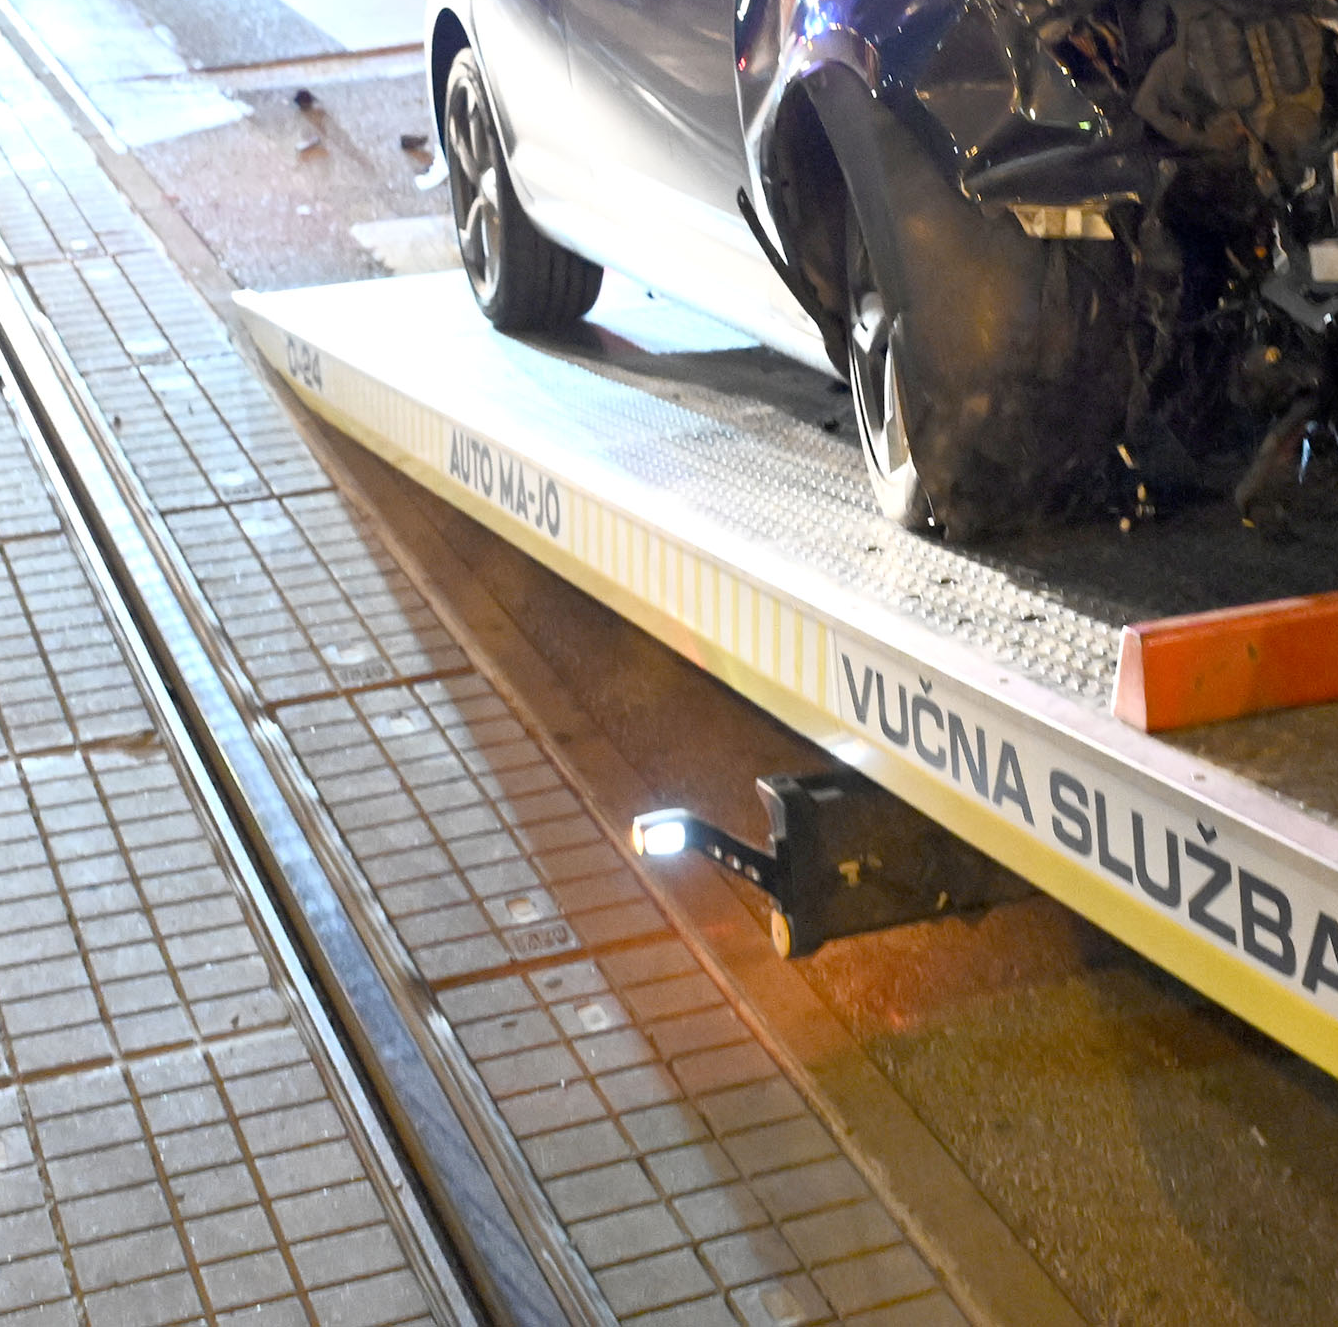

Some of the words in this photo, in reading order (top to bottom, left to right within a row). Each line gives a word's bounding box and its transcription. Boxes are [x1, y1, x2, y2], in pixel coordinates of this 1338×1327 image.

[450, 428, 493, 497] AUTO
[499, 451, 560, 538] MA-JO
[842, 653, 1034, 826] VUČNA
